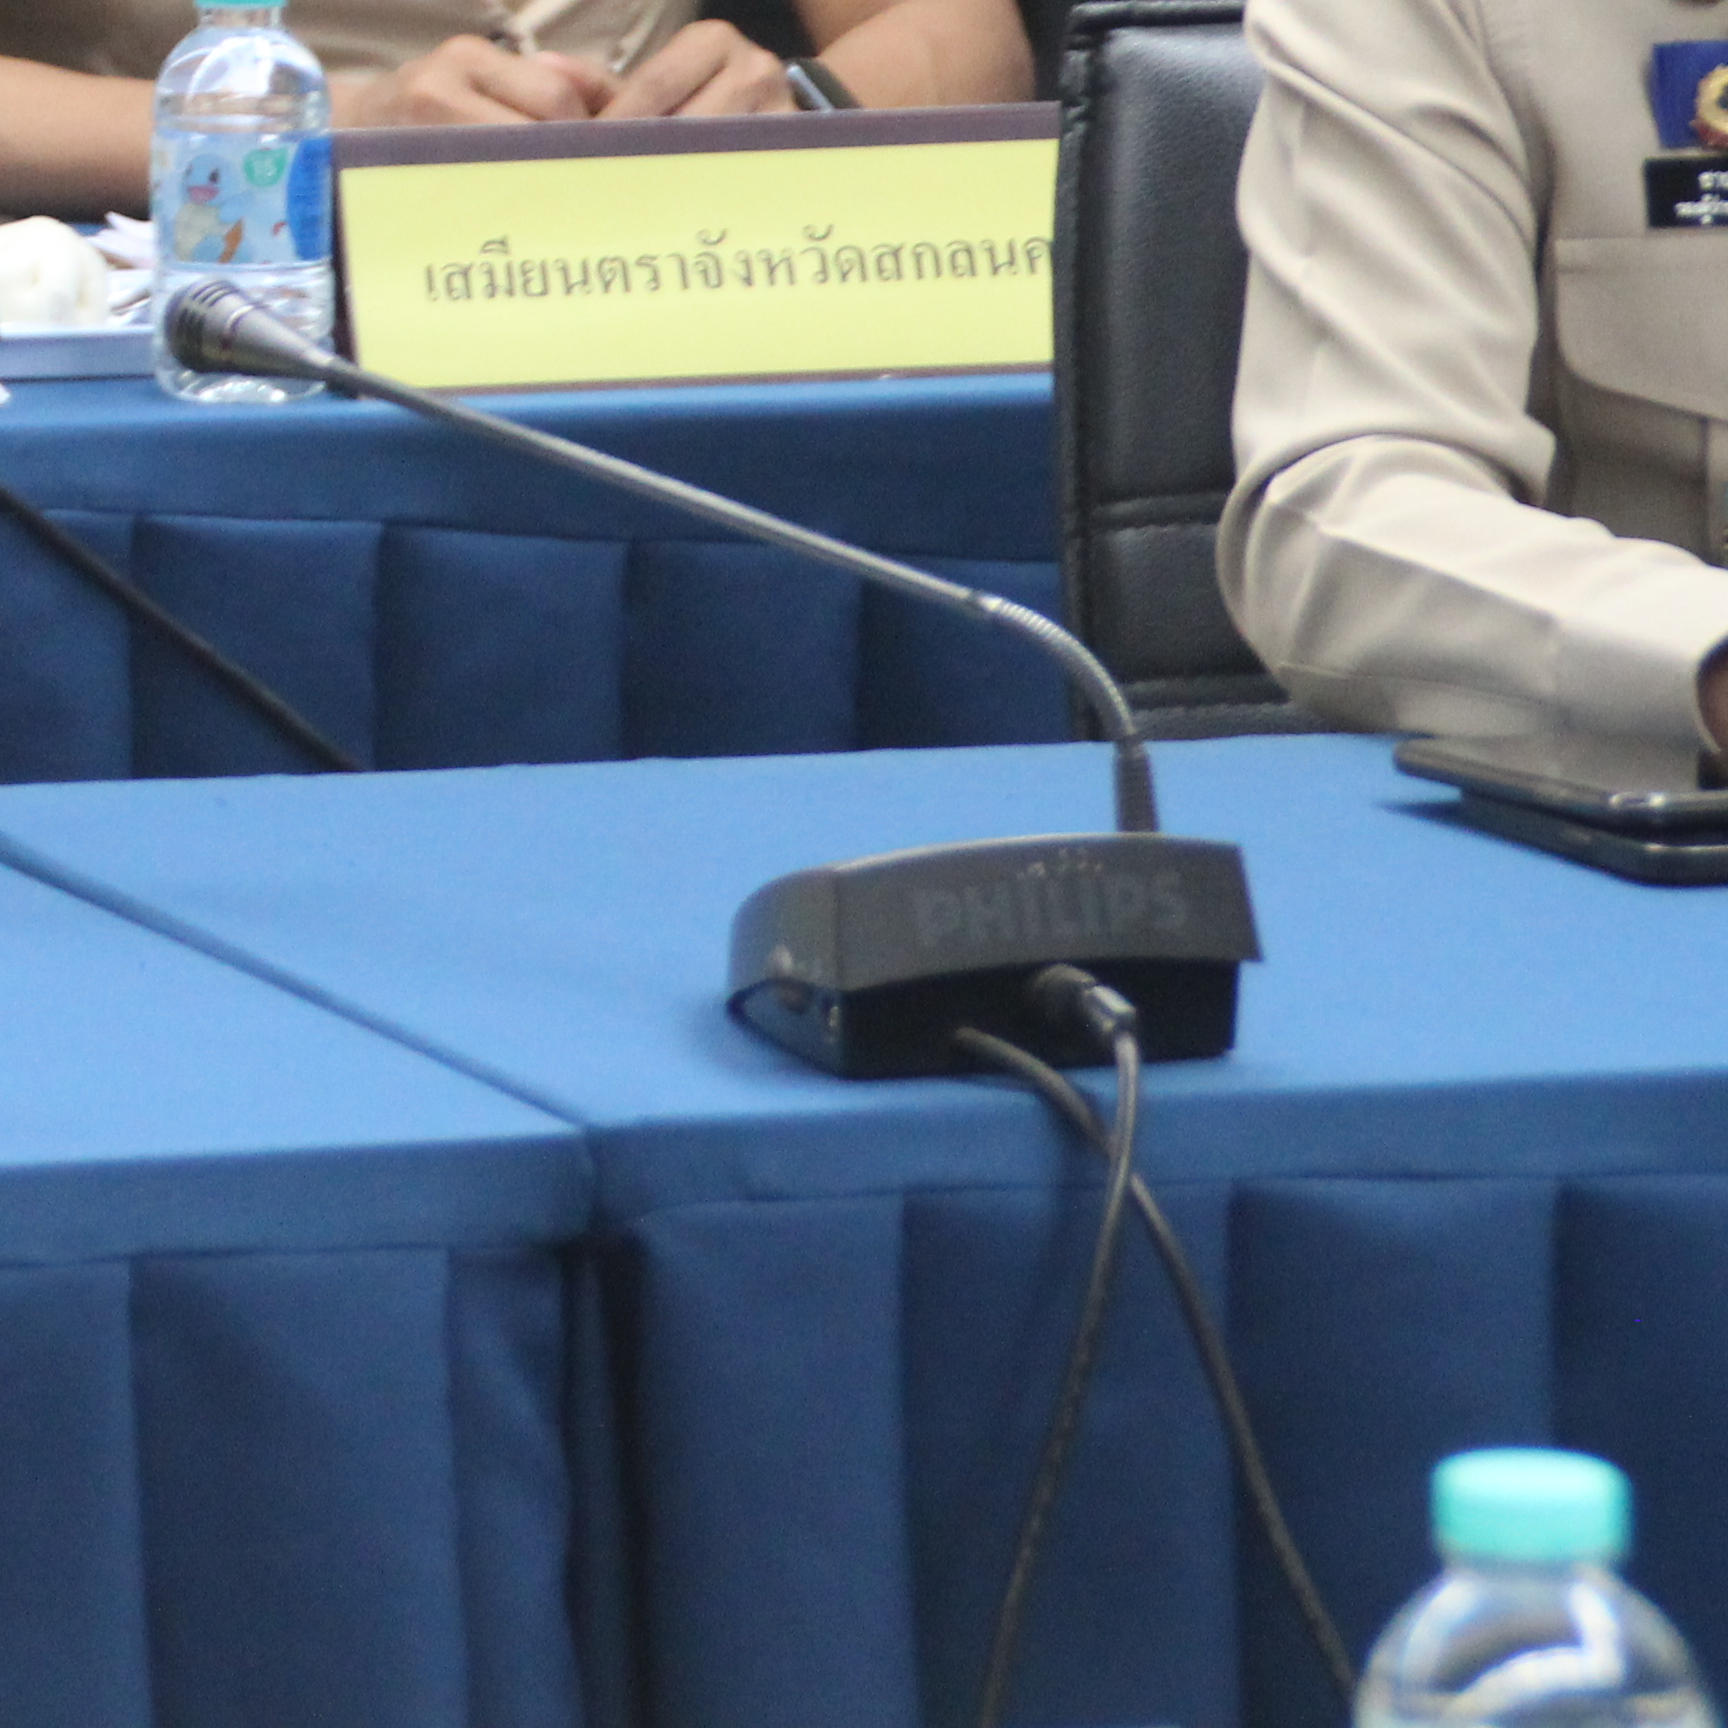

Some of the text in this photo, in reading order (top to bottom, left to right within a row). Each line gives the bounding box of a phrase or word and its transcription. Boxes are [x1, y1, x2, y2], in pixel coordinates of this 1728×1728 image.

[422, 222, 1056, 302] เสมียนตราจังหวัดสกลนค
[911, 869, 1187, 948] PHILIPS
